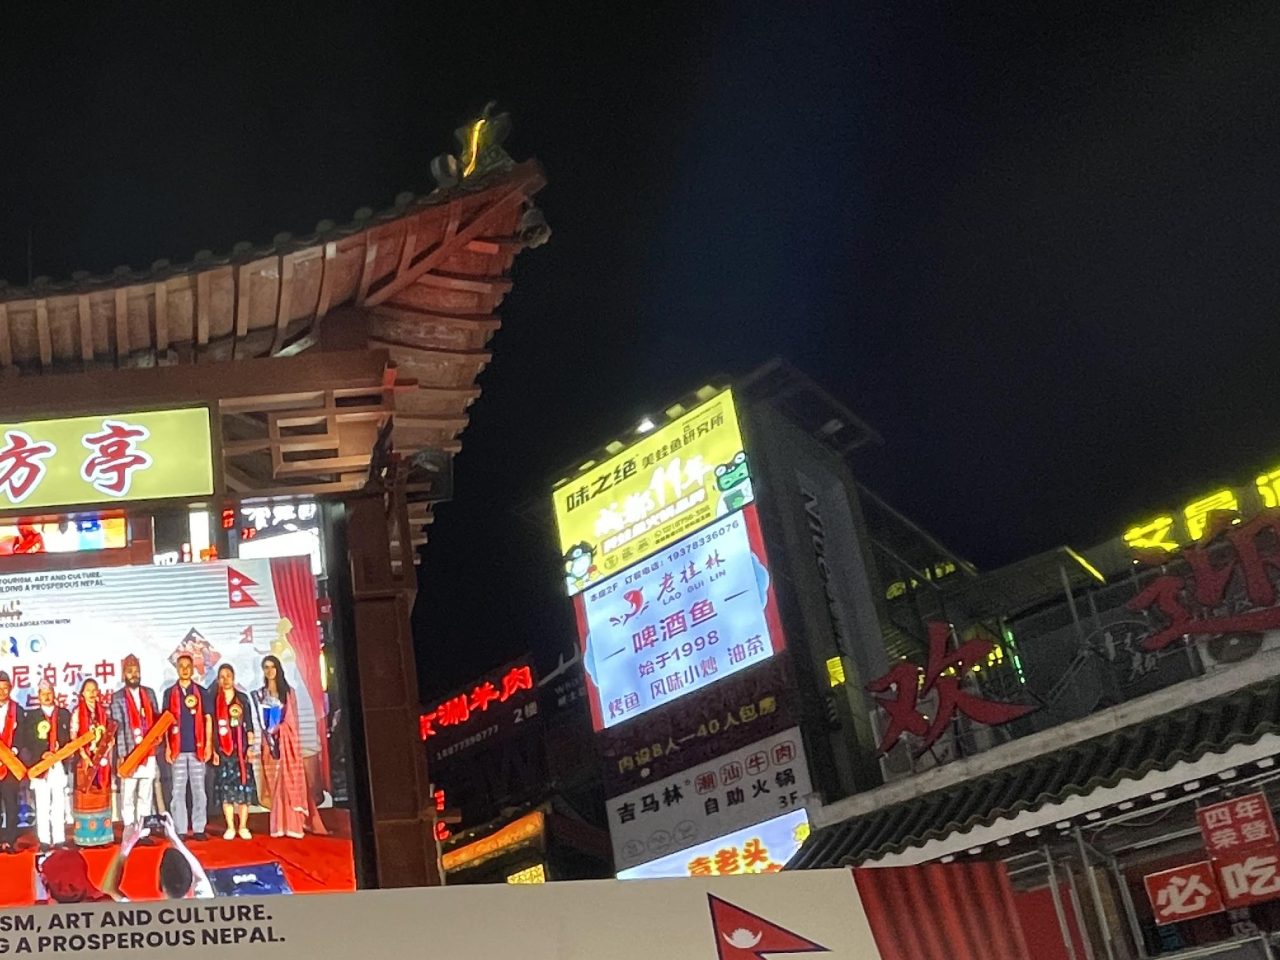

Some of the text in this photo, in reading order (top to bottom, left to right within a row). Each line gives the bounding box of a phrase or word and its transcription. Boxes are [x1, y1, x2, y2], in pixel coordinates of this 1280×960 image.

[662, 591, 682, 606] LAO
[709, 568, 727, 584] LIN
[632, 598, 718, 654] 啤酒鱼
[638, 630, 720, 678] 始于1998
[11, 659, 124, 689] 尼泊尔-中
[649, 656, 718, 700] 风味小炒
[703, 767, 797, 817] 自助火锅
[778, 790, 799, 809] 3F
[1204, 798, 1264, 830] 四年
[1155, 855, 1280, 918] 必吃
[48, 911, 94, 931] ART
[100, 909, 153, 928] AND
[158, 904, 273, 925] CULTURE.
[15, 936, 33, 954] A
[38, 929, 196, 953] PROSPEROUS
[202, 925, 286, 946] NEPAL.
